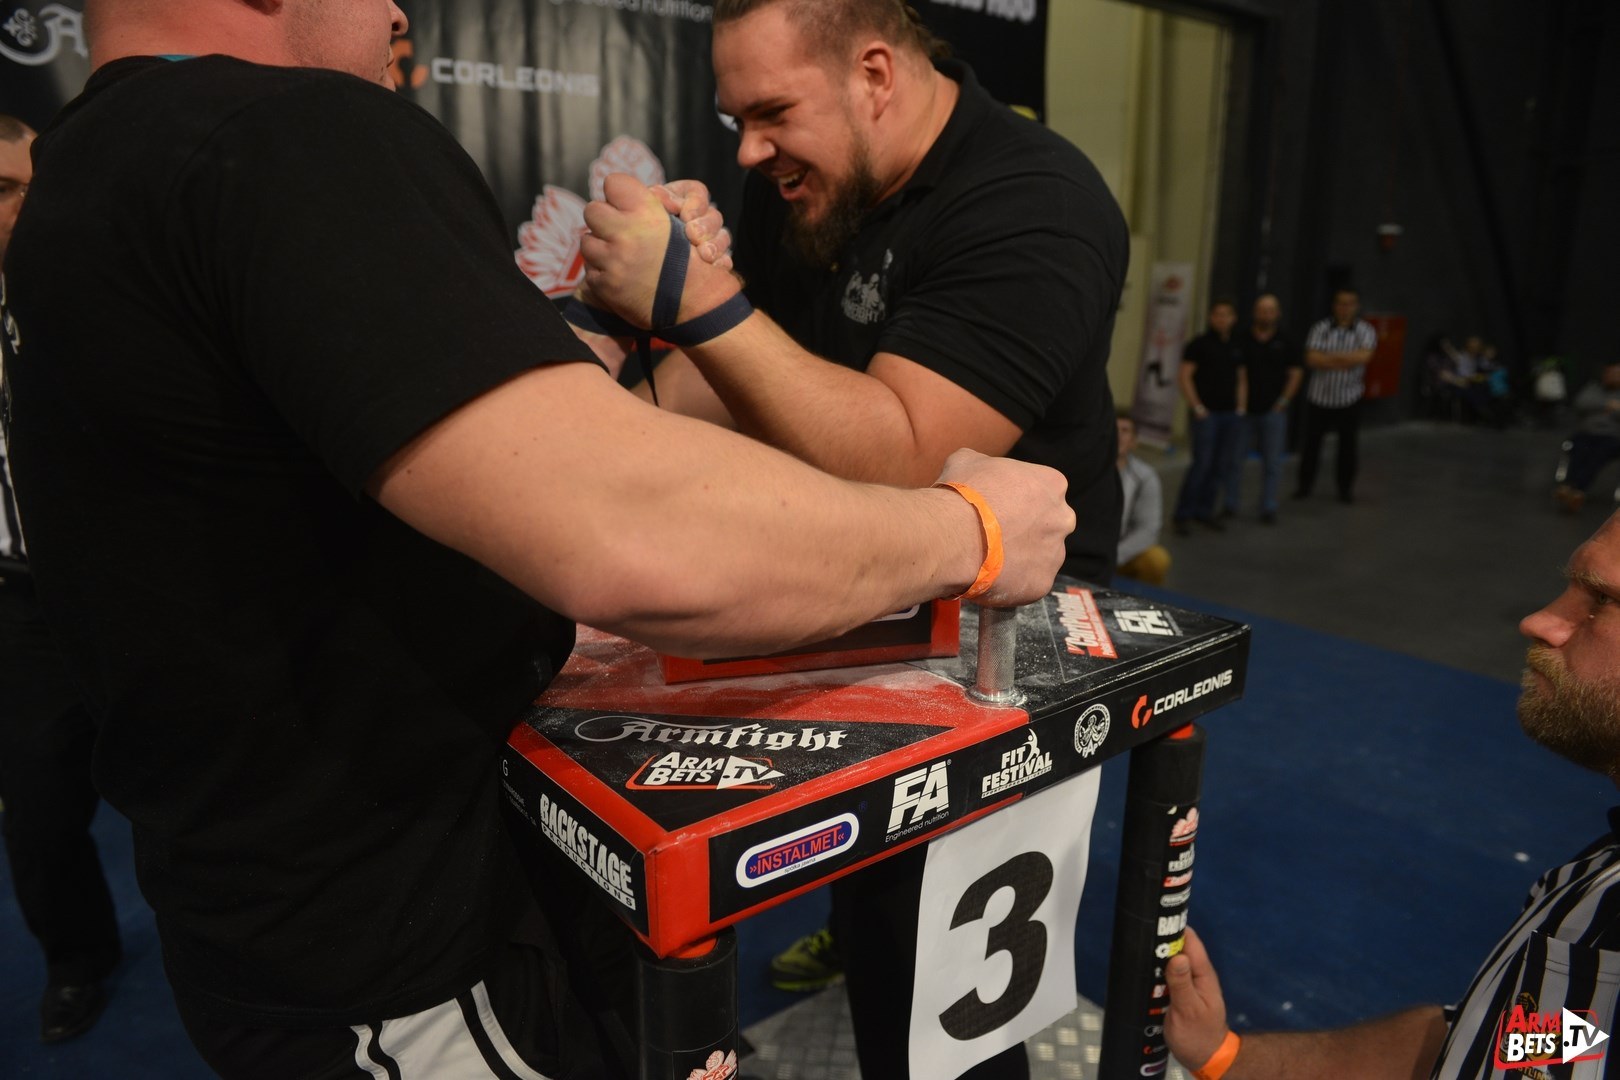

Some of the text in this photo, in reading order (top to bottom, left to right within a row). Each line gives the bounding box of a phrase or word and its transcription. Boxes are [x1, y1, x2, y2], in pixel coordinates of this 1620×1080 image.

[431, 57, 599, 97] CORLEONIS
[1153, 669, 1233, 716] CORLEONIS
[575, 715, 849, 751] Armfight
[643, 767, 715, 786] BETS
[651, 751, 726, 770] ARM
[981, 751, 1053, 793] FESTIVAL
[1001, 746, 1026, 770] FIT
[886, 760, 949, 834] FA
[539, 793, 634, 897] BACKSTAGE
[885, 811, 950, 843] Engineered nutrition
[541, 824, 635, 908] PRODUCTIONS
[938, 851, 1054, 1041] 3
